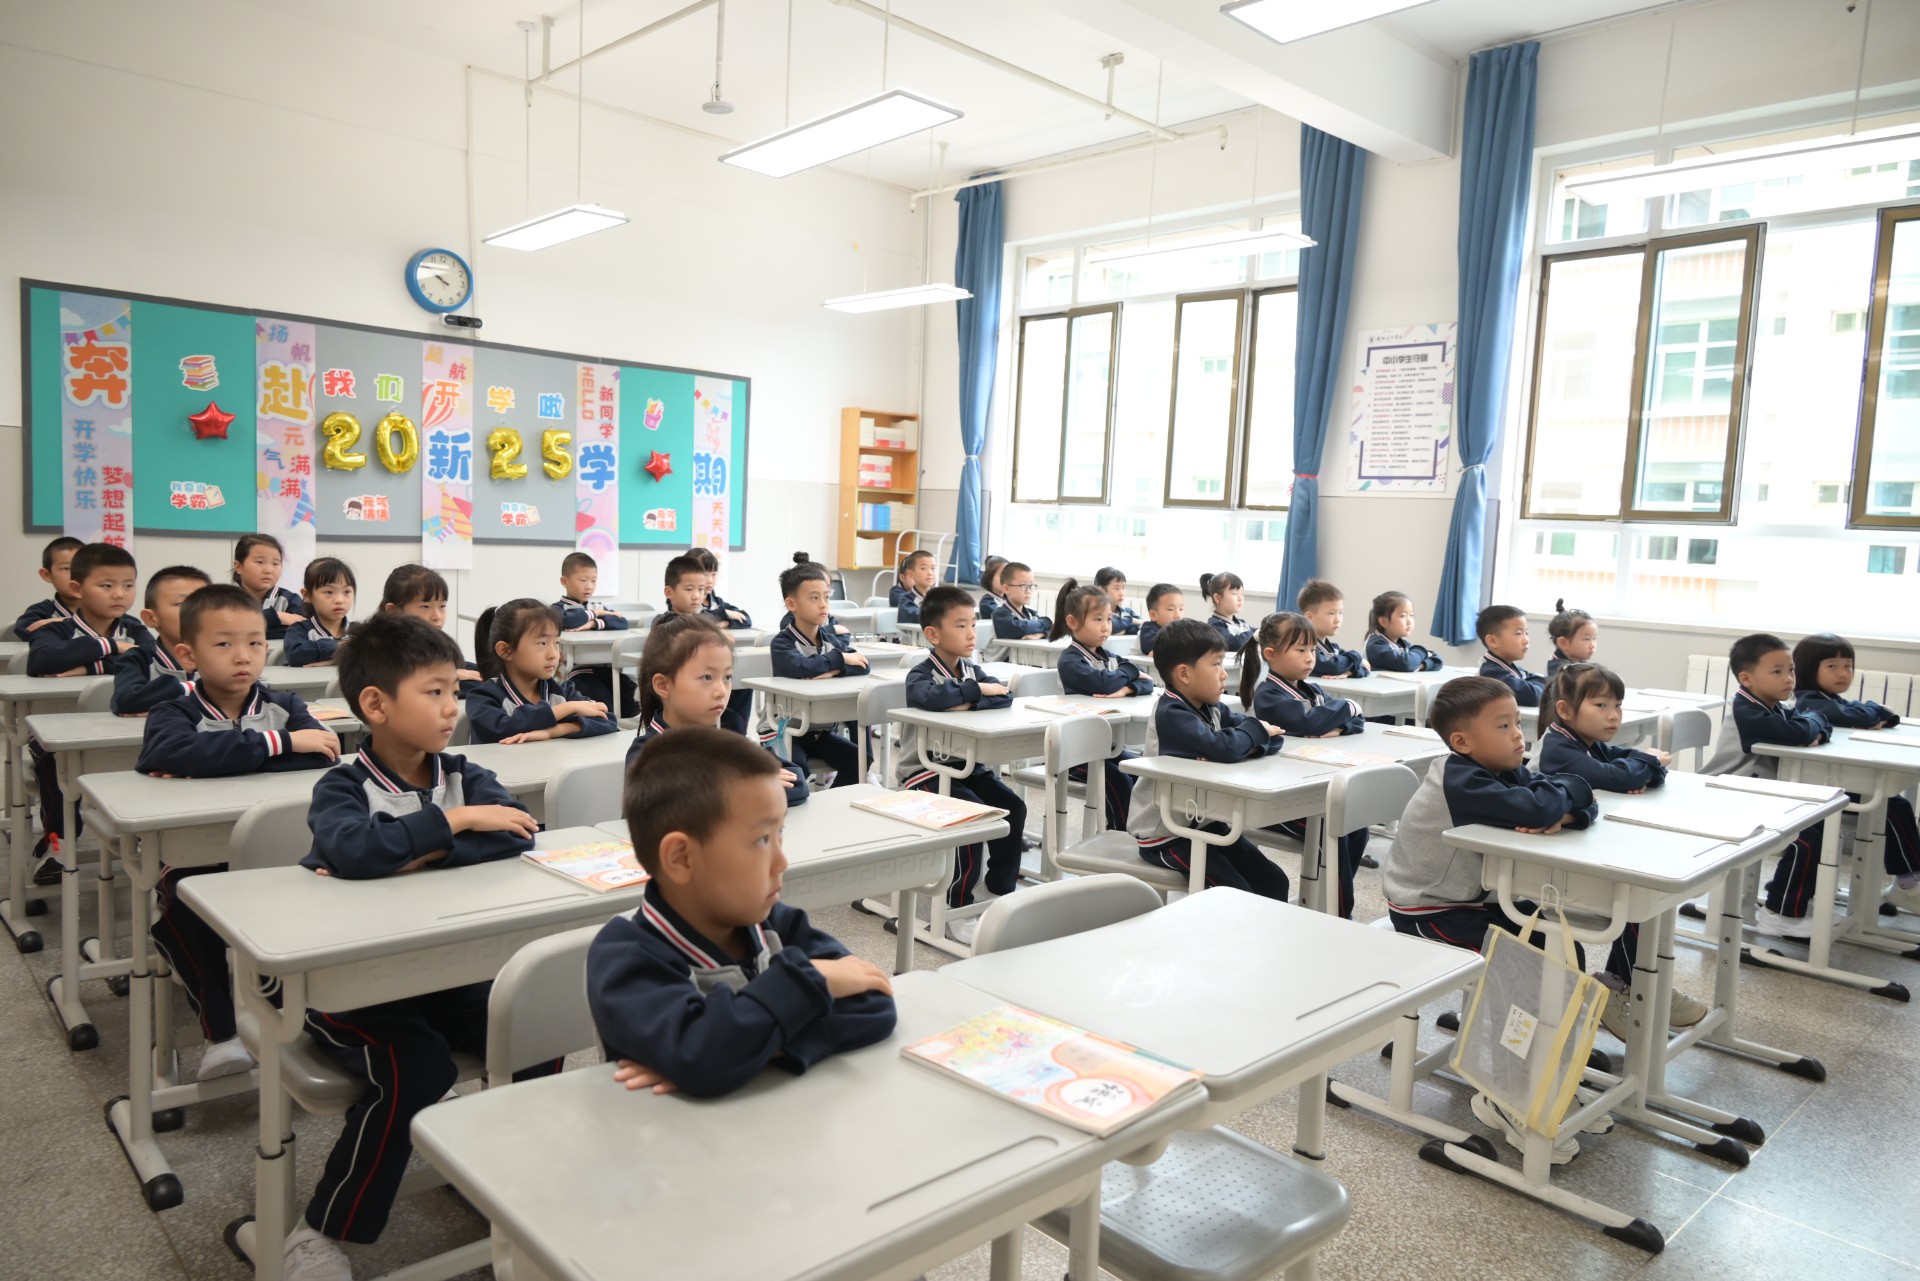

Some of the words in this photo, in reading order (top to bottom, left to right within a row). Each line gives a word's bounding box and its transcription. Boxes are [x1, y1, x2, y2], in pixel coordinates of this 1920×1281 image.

[268, 324, 312, 362] 扬帆
[69, 341, 129, 404] 奔
[259, 365, 309, 421] 赴
[428, 430, 472, 481] 新
[579, 444, 616, 490] 学
[694, 452, 727, 496] 期
[582, 366, 594, 420] HELLO
[600, 386, 614, 439] 新同学
[74, 419, 96, 510] 开学快乐
[171, 493, 206, 508] 学霸
